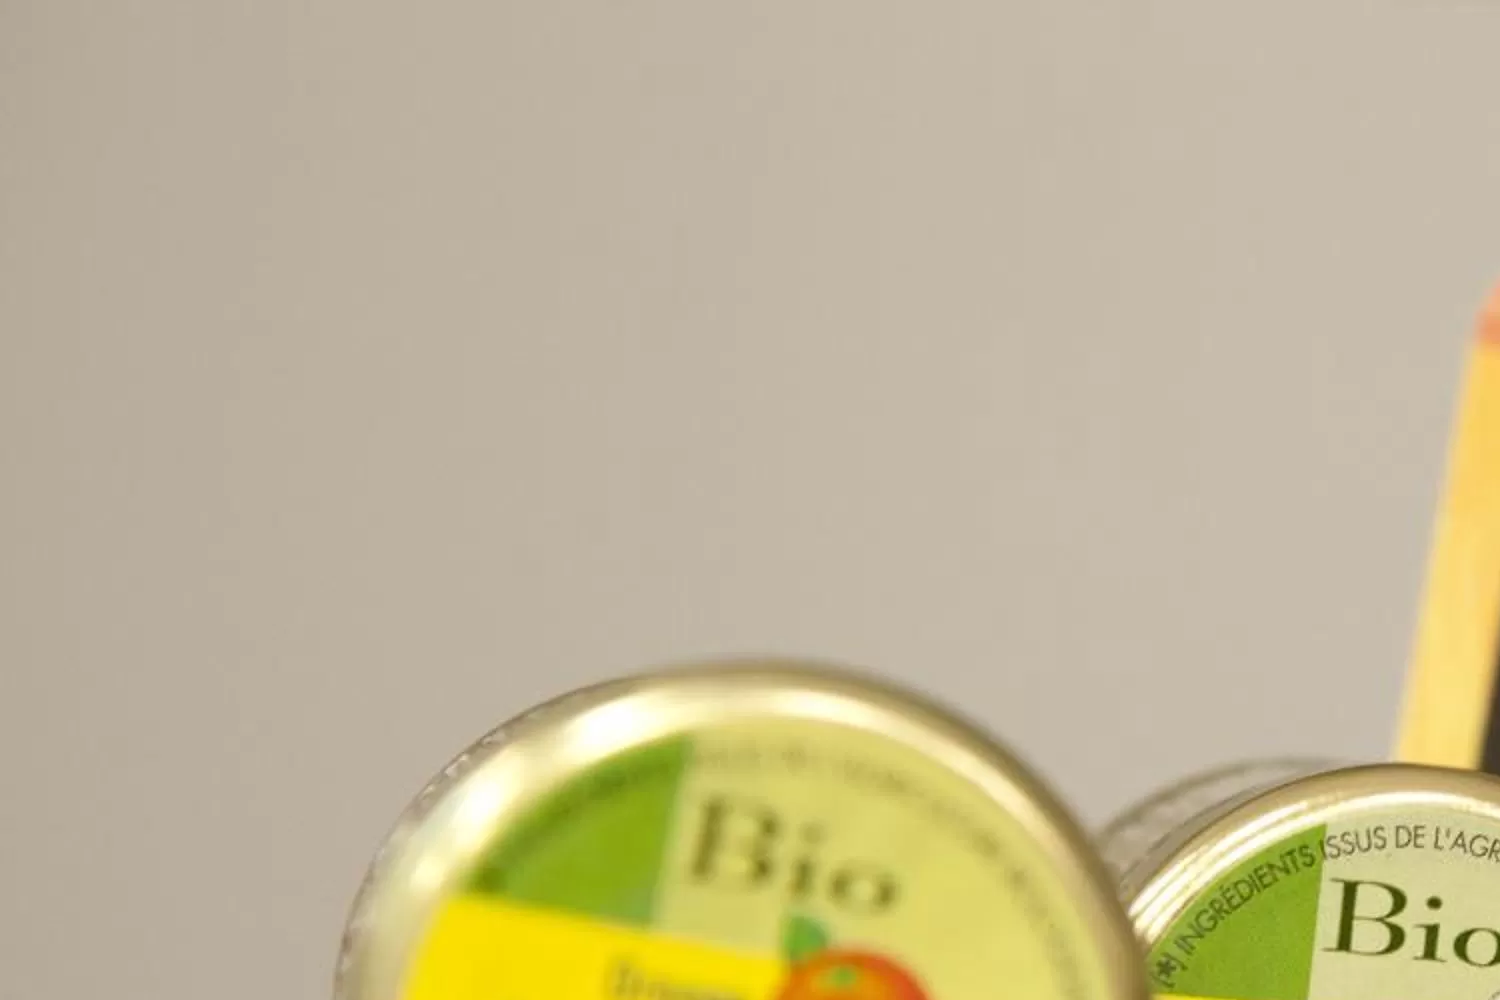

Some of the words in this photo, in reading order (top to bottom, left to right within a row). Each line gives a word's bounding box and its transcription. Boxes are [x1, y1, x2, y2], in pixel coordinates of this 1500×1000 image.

[684, 797, 900, 914] Bio
[1173, 844, 1317, 956] INGRÉDIENTS
[1319, 826, 1388, 861] ISSUS
[1394, 825, 1427, 850] DE
